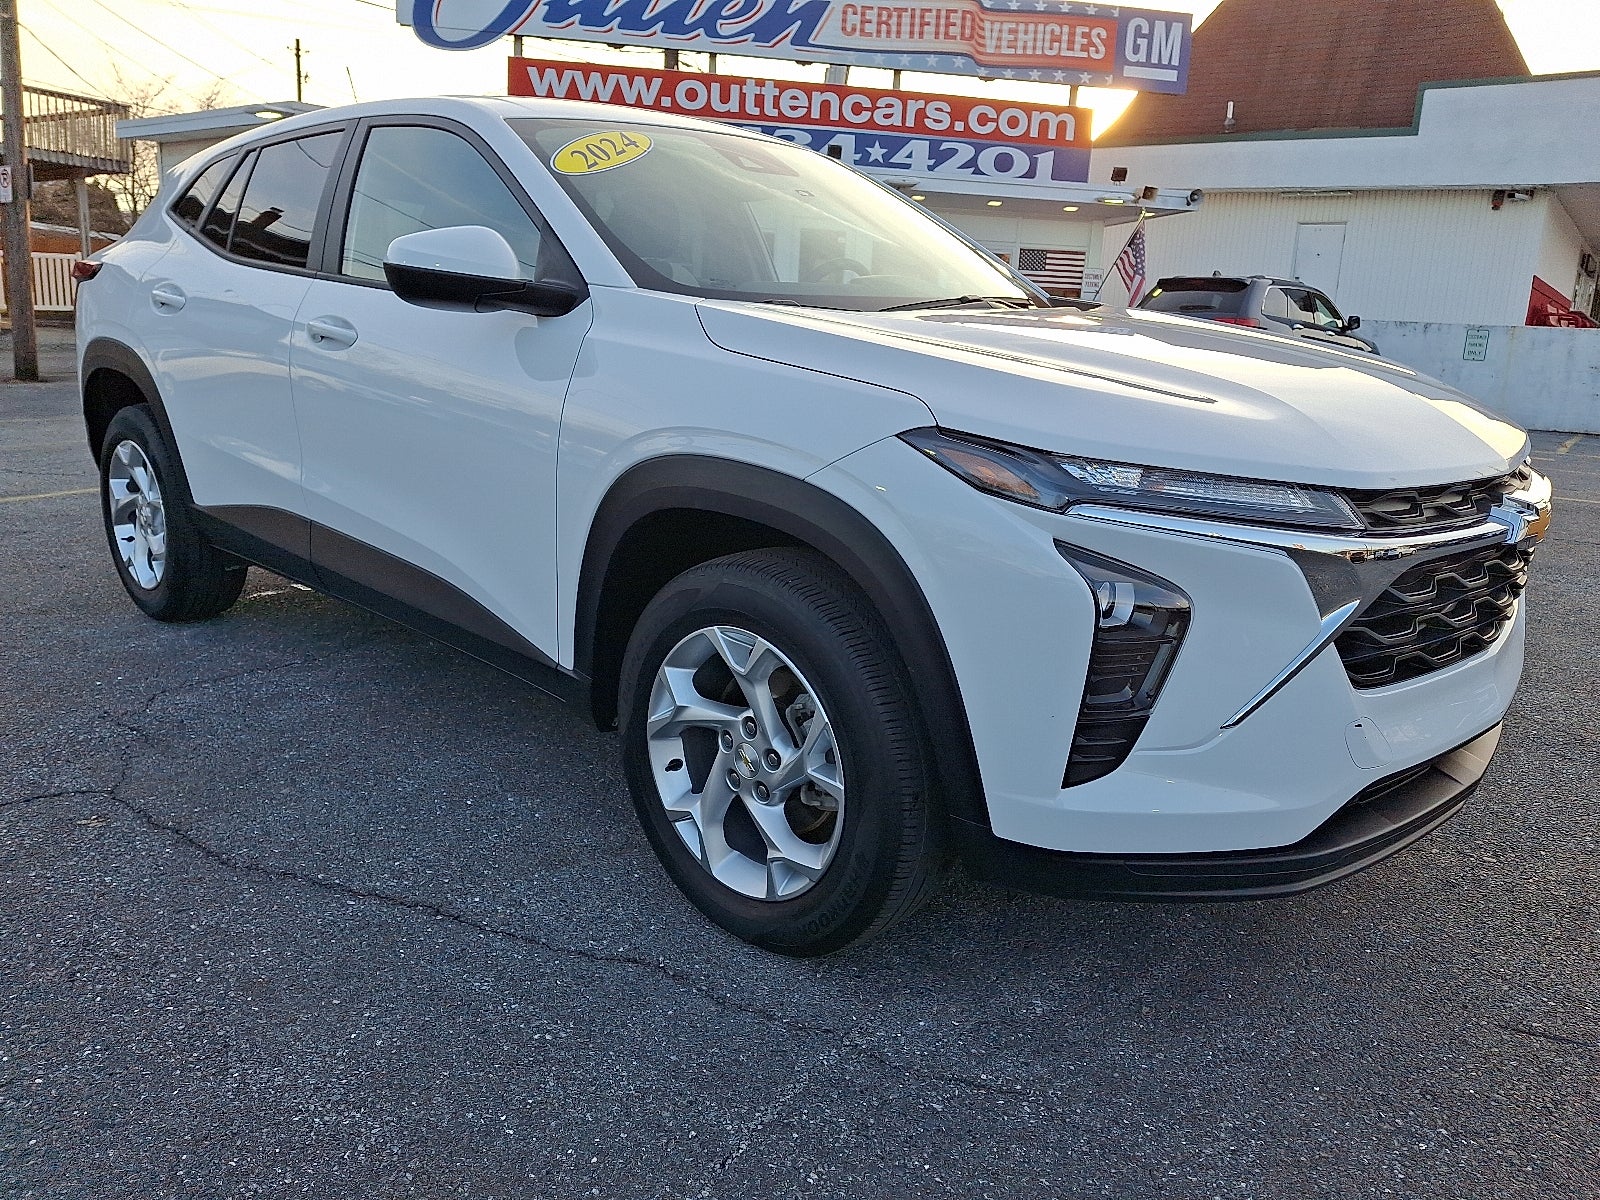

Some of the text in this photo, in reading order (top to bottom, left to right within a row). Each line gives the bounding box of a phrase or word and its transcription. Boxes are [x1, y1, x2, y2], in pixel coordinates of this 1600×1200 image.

[841, 3, 1108, 60] CERTIFIED VEHICLES
[1125, 17, 1184, 66] GM
[527, 66, 1076, 141] www.outtencars.com
[570, 131, 640, 169] 2024
